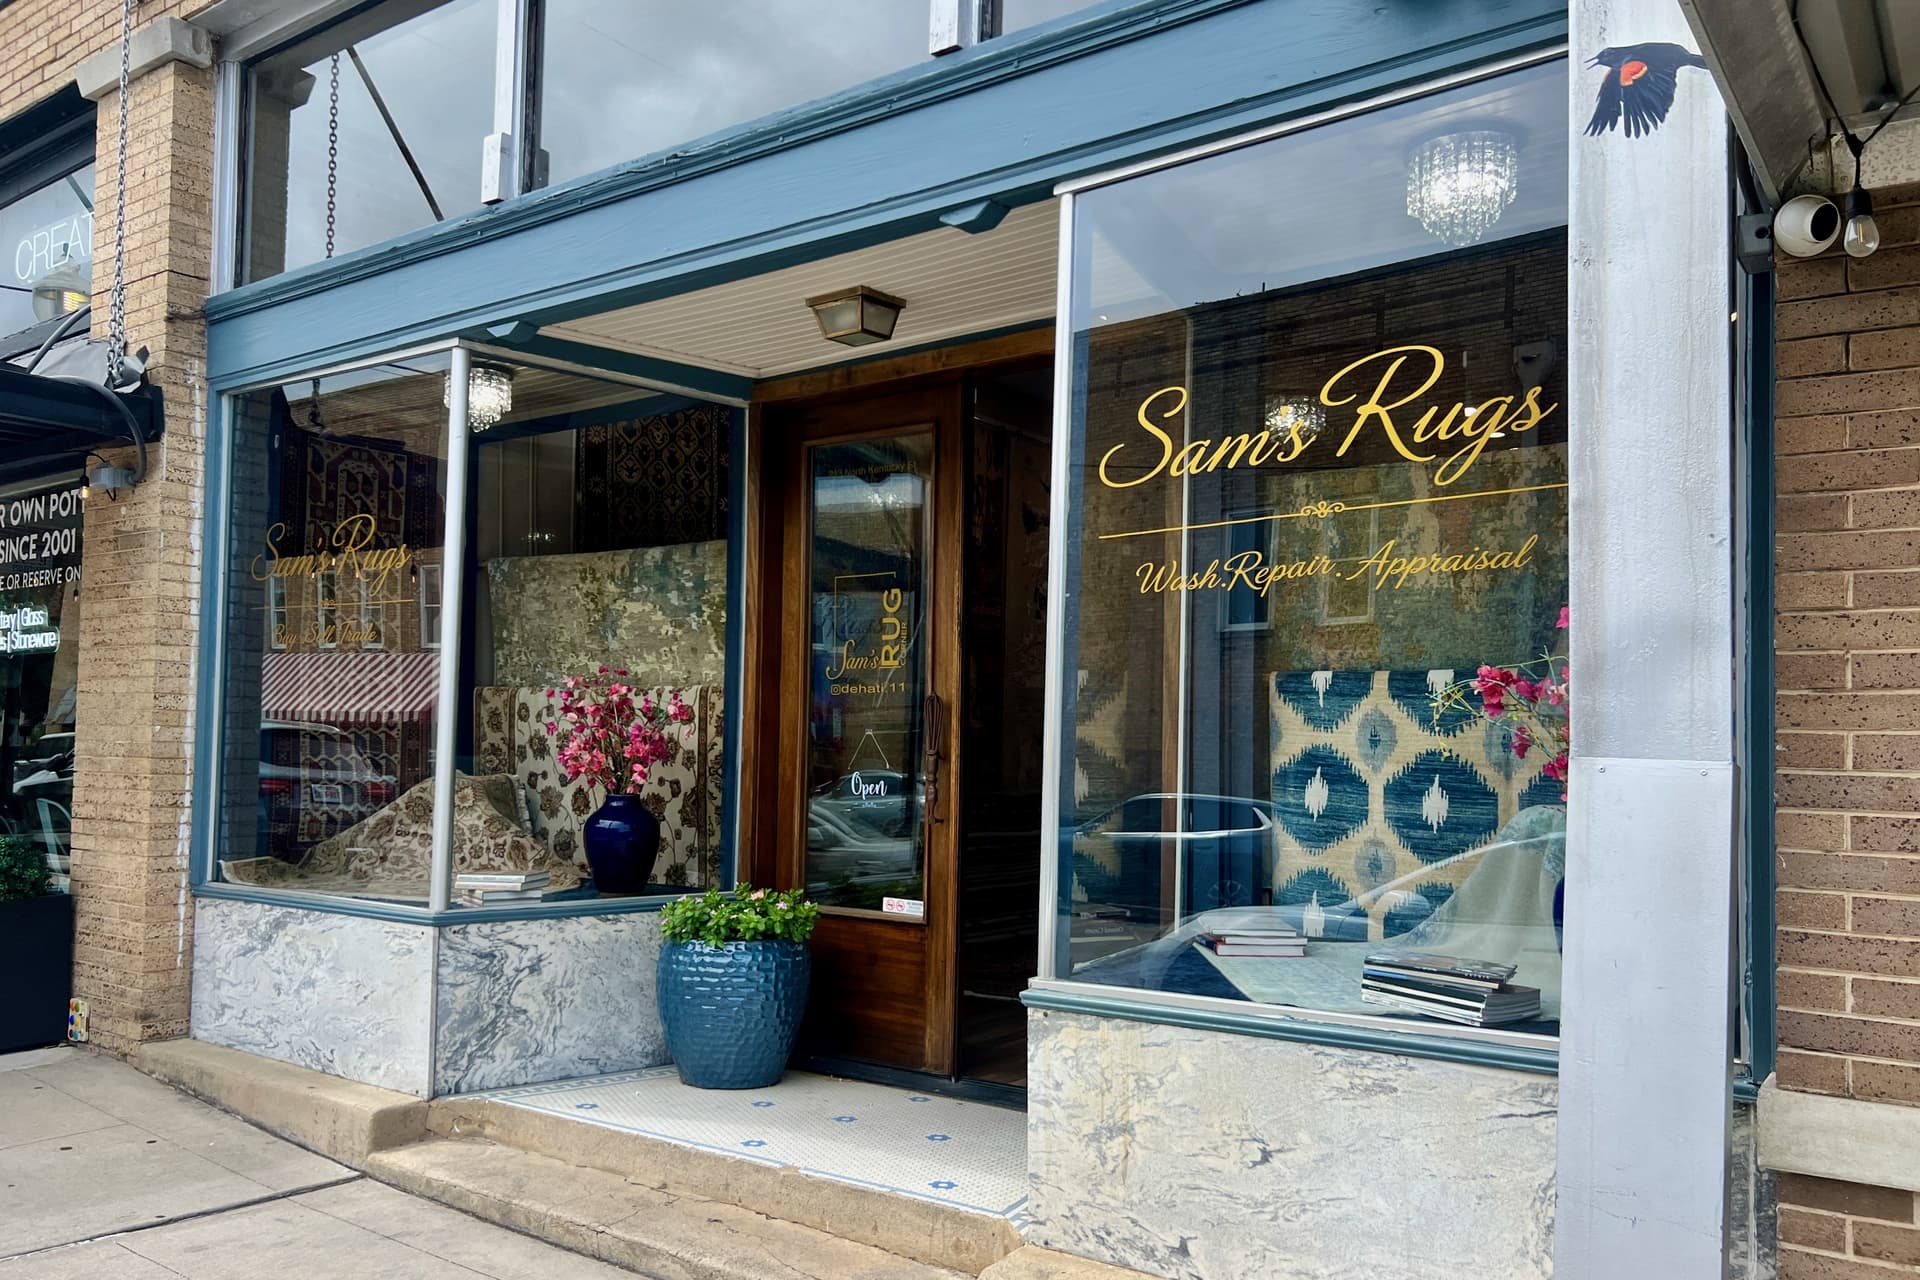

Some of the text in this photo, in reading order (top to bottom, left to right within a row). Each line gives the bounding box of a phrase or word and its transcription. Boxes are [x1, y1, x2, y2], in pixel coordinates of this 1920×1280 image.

[1098, 344, 1558, 488] Sam's Rugs
[10, 496, 45, 526] OWN
[0, 527, 76, 564] SINCE 2001
[252, 513, 412, 597] Sam's Rugs
[1346, 534, 1540, 590] Appraisal
[7, 574, 20, 590] OR
[22, 566, 62, 588] RESERVE
[65, 565, 81, 582] ON
[274, 619, 378, 653] Buy Sell Trade
[881, 587, 903, 666] RUG
[825, 639, 881, 681] Sam's
[851, 771, 888, 800] Open
